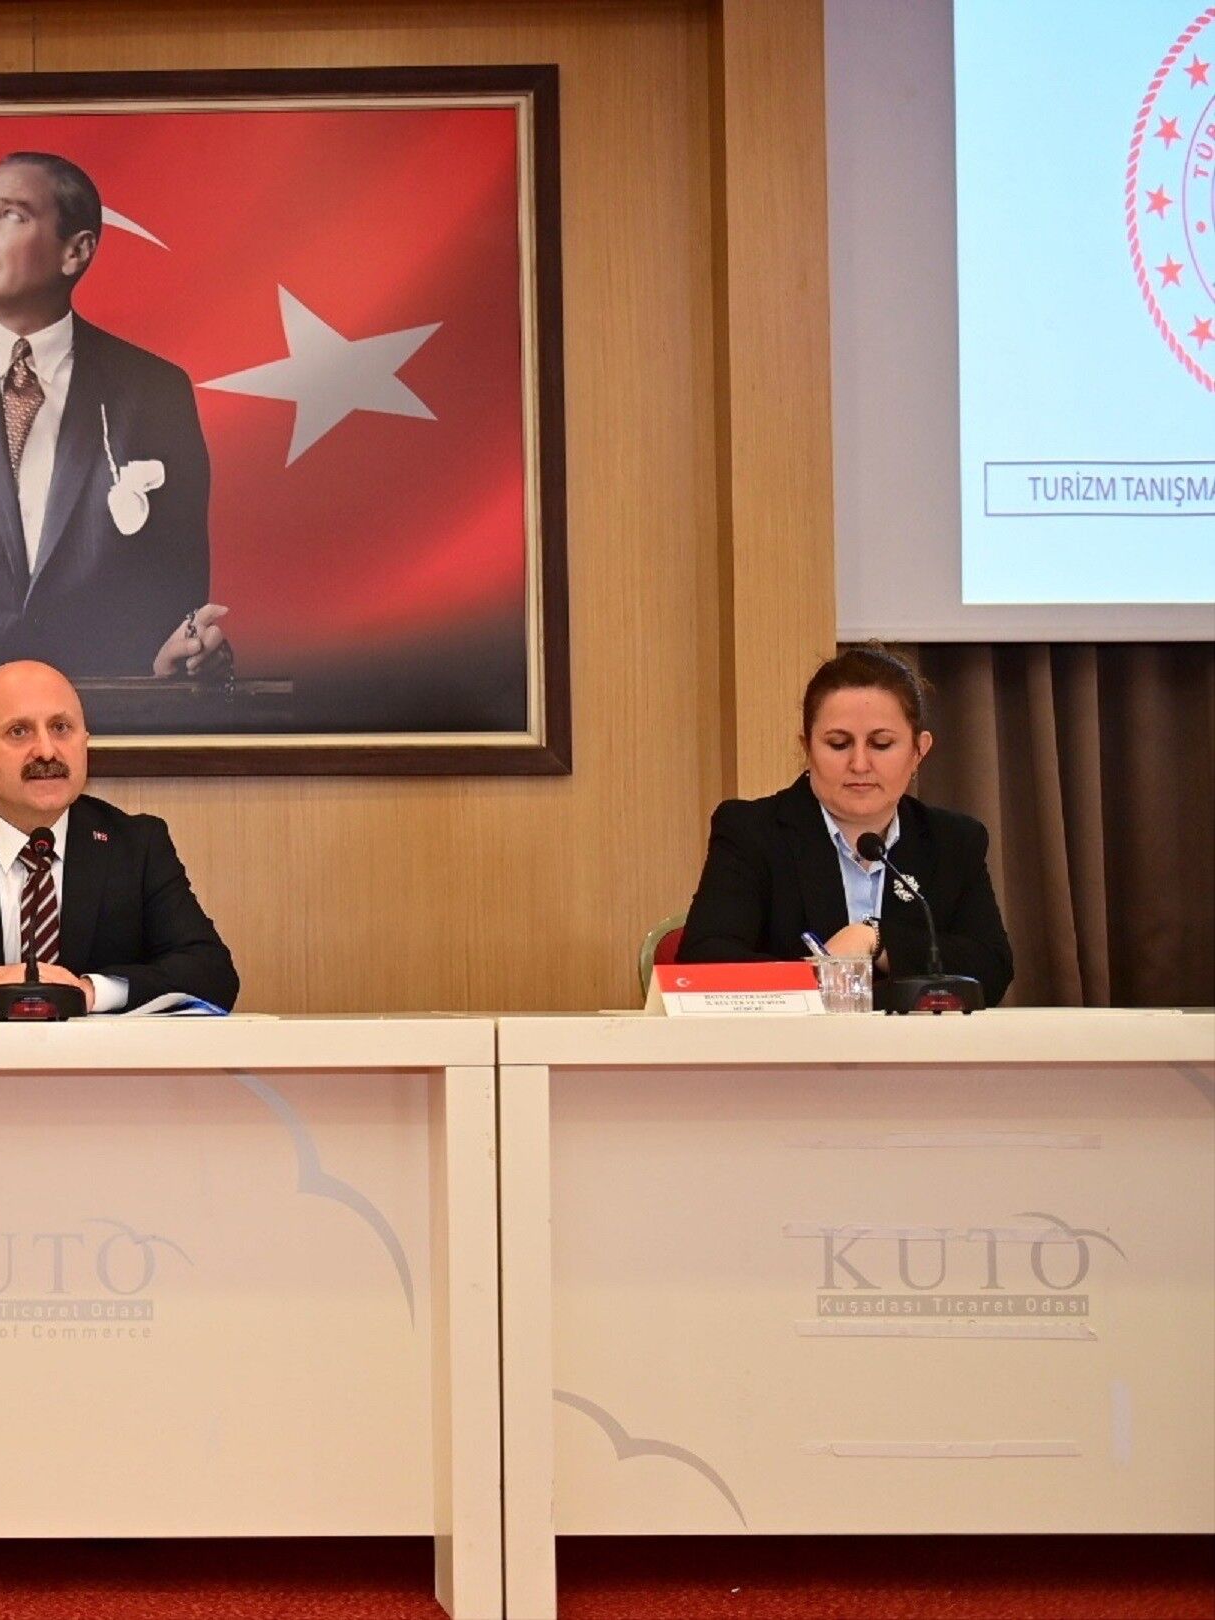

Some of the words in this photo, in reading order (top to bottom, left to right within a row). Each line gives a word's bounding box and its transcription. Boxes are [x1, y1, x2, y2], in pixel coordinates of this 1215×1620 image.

[1028, 471, 1116, 501] TURİZM
[817, 1228, 1089, 1290] KUTO
[0, 1303, 79, 1318] Ticaret
[91, 1302, 152, 1318] Odası
[819, 1298, 922, 1315] Kuşadası
[934, 1298, 1014, 1313] Ticaret
[1025, 1298, 1087, 1313] Odası
[32, 1324, 153, 1339] Commerce
